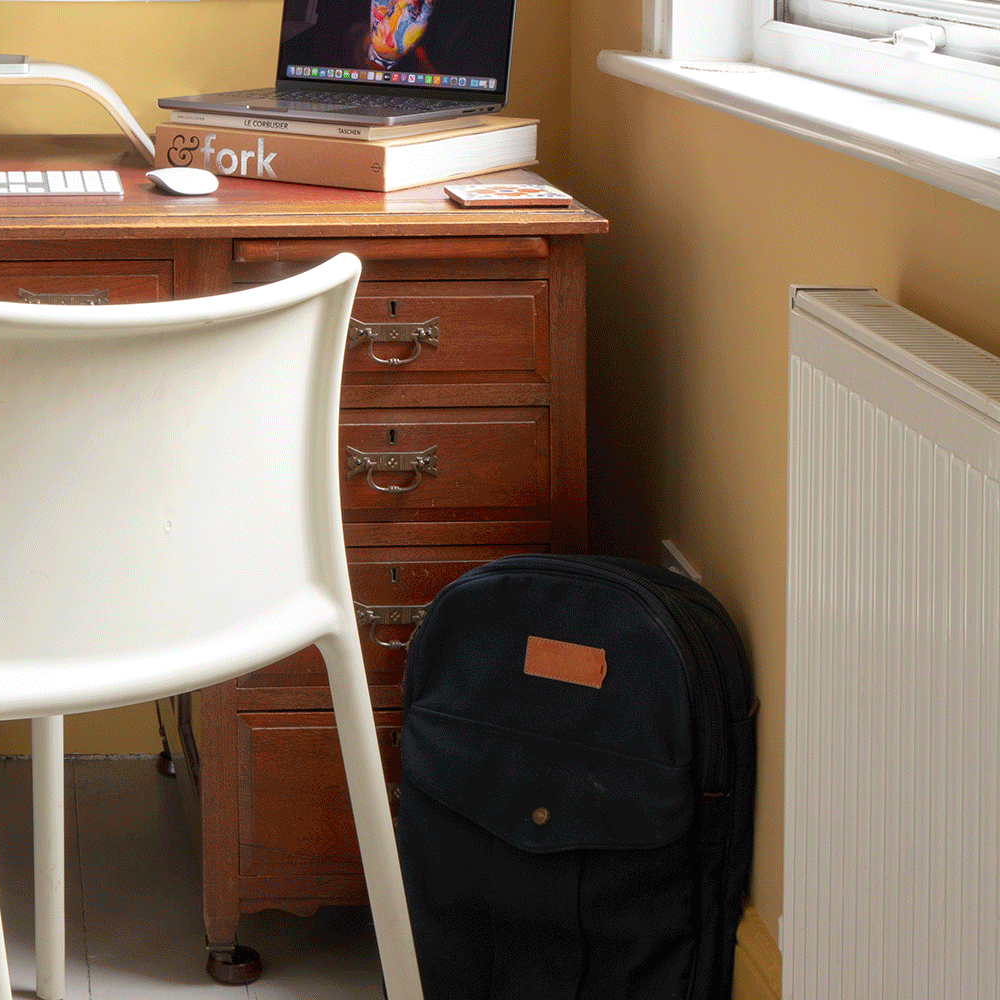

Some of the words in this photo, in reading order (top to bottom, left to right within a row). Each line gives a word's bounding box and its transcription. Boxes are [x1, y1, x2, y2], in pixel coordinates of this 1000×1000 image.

[244, 119, 252, 127] LE
[253, 120, 289, 129] CORBUSIER
[338, 127, 361, 136] TASCHEN
